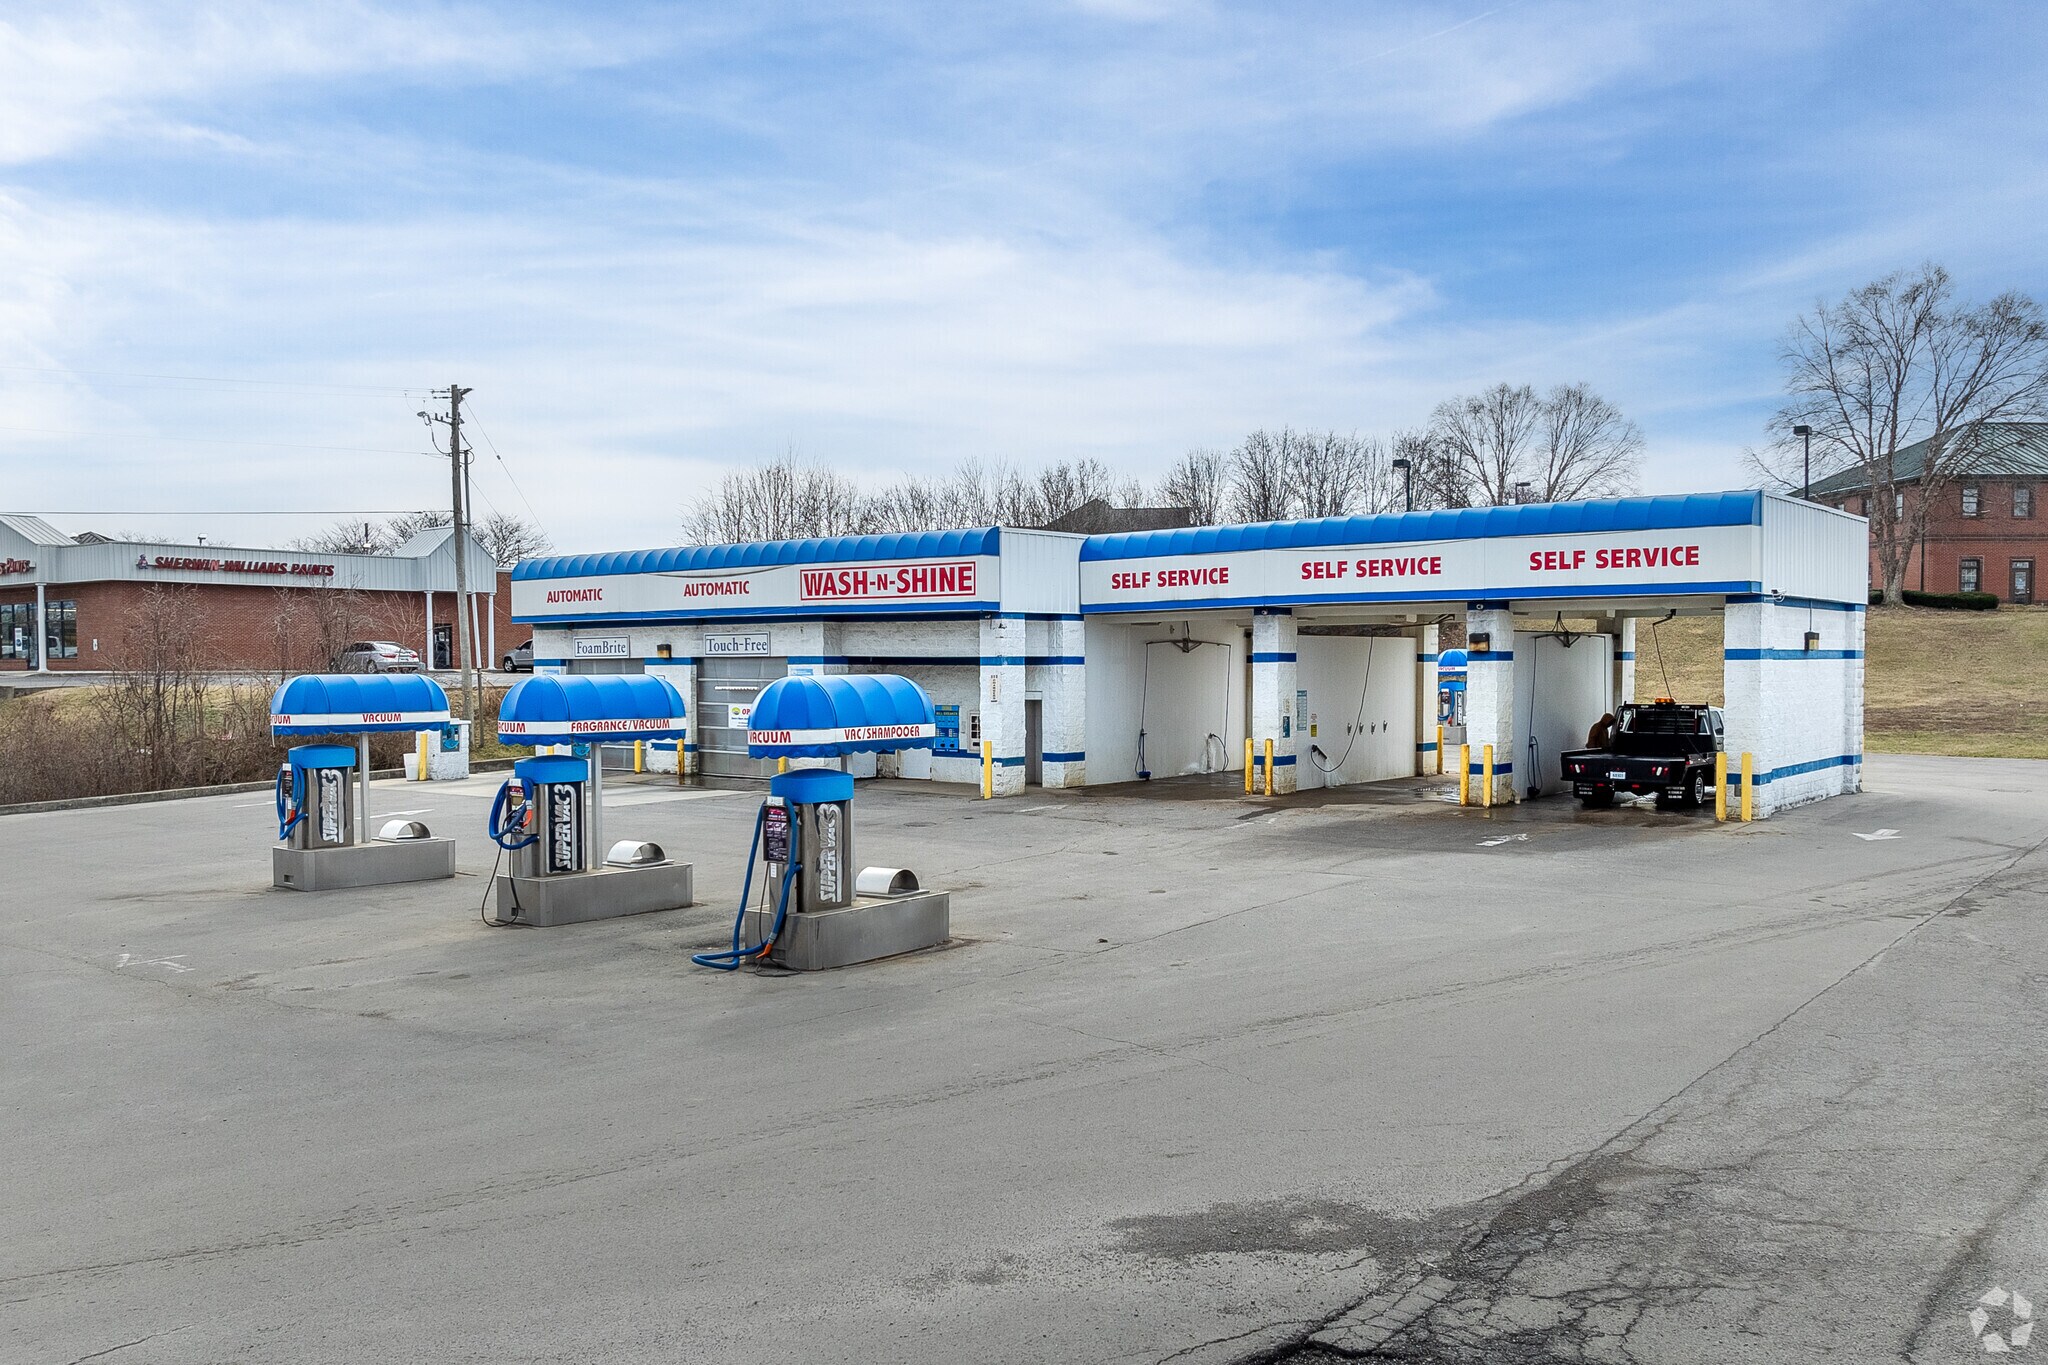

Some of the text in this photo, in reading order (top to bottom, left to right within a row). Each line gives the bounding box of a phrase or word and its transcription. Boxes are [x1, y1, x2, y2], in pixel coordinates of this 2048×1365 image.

[1530, 546, 1699, 571] SELF SERVICE
[290, 563, 335, 577] PAINTS
[1301, 557, 1442, 580] SELF SERVICE
[803, 566, 973, 597] WASH-N-SHINE
[1111, 567, 1229, 590] SELF SERVICE
[546, 588, 603, 603] AUTOMATIC
[684, 580, 750, 597] AUTOMATIC
[576, 640, 626, 654] FoamBrite
[706, 637, 767, 652] Touch-Free
[362, 713, 402, 723] VACUUM
[571, 719, 670, 732] FRAGRANCE/VACUUM
[749, 731, 792, 744] VACUUM
[844, 725, 920, 740] VAC/SHAMPOOER
